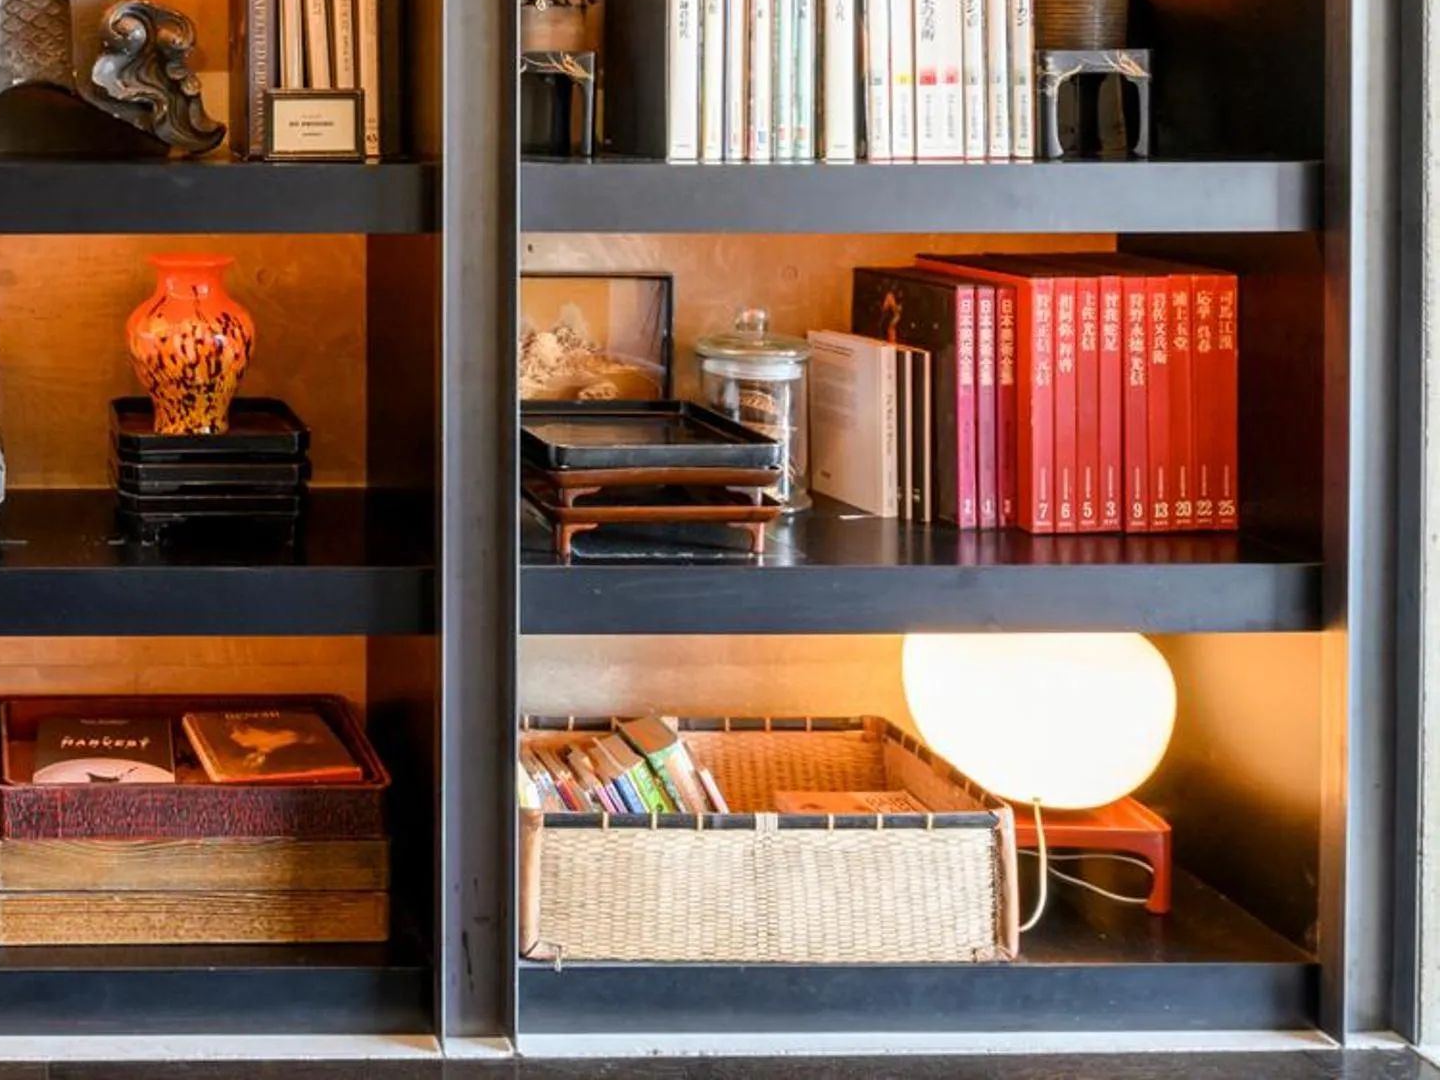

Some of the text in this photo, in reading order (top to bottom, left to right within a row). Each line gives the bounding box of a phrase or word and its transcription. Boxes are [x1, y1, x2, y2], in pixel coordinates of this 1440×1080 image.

[1039, 502, 1049, 518] 7
[1061, 502, 1071, 519] 6
[1082, 501, 1093, 518] 5
[1106, 501, 1116, 518] 3
[1132, 502, 1143, 519] 9
[1195, 499, 1214, 517] 22
[1217, 499, 1236, 517] 25
